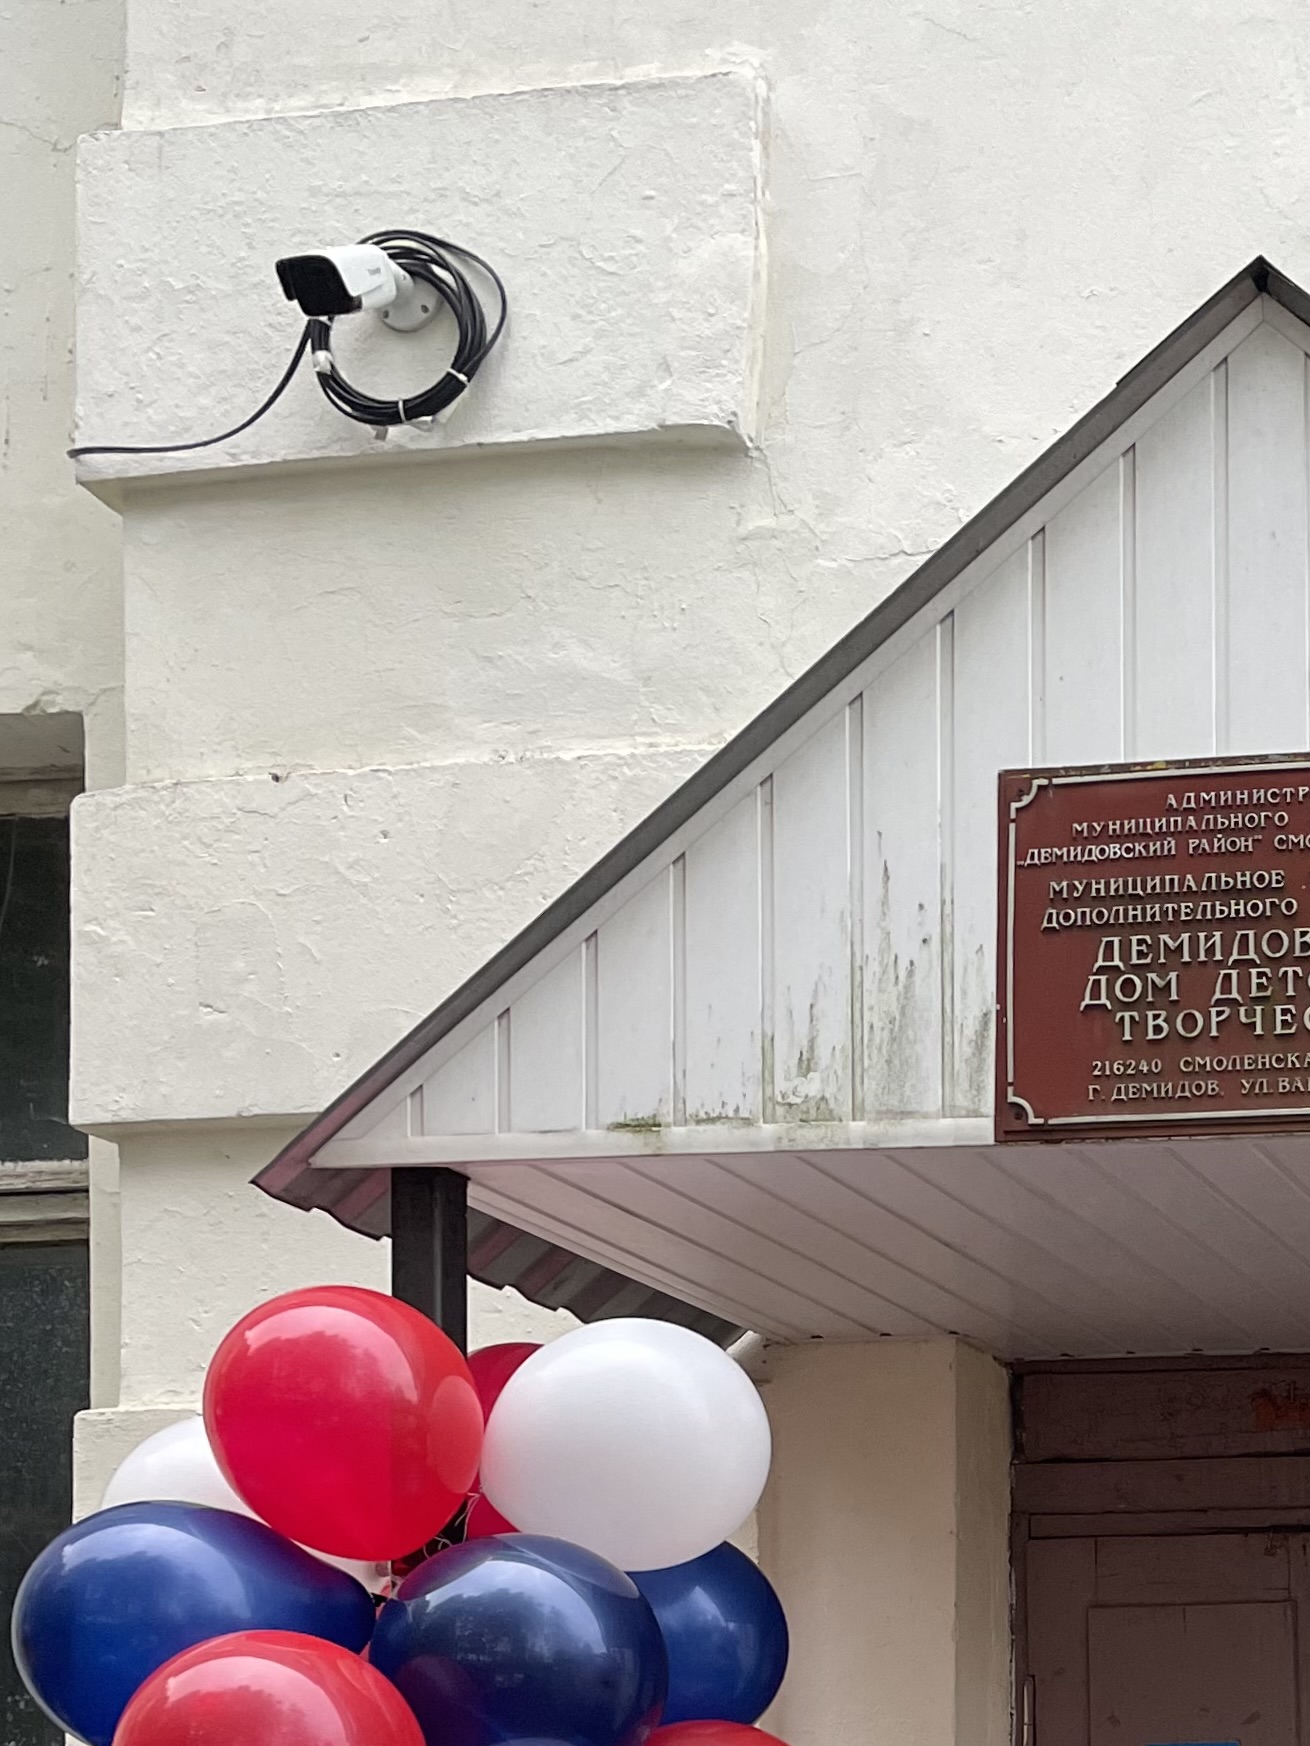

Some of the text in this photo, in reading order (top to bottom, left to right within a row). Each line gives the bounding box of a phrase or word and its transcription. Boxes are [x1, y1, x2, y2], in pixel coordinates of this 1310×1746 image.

[1072, 811, 1289, 838] МУНИЦИПАЛЬНОГО
[1049, 870, 1285, 900] МУНИЦИПАЛЬНОЕ
[1042, 898, 1297, 930] ДОПОЛНИТЕЛЬНОГО
[1080, 972, 1179, 1011] ДОМ
[1092, 1059, 1162, 1075] 216240
[1089, 1084, 1105, 1101] Г.
